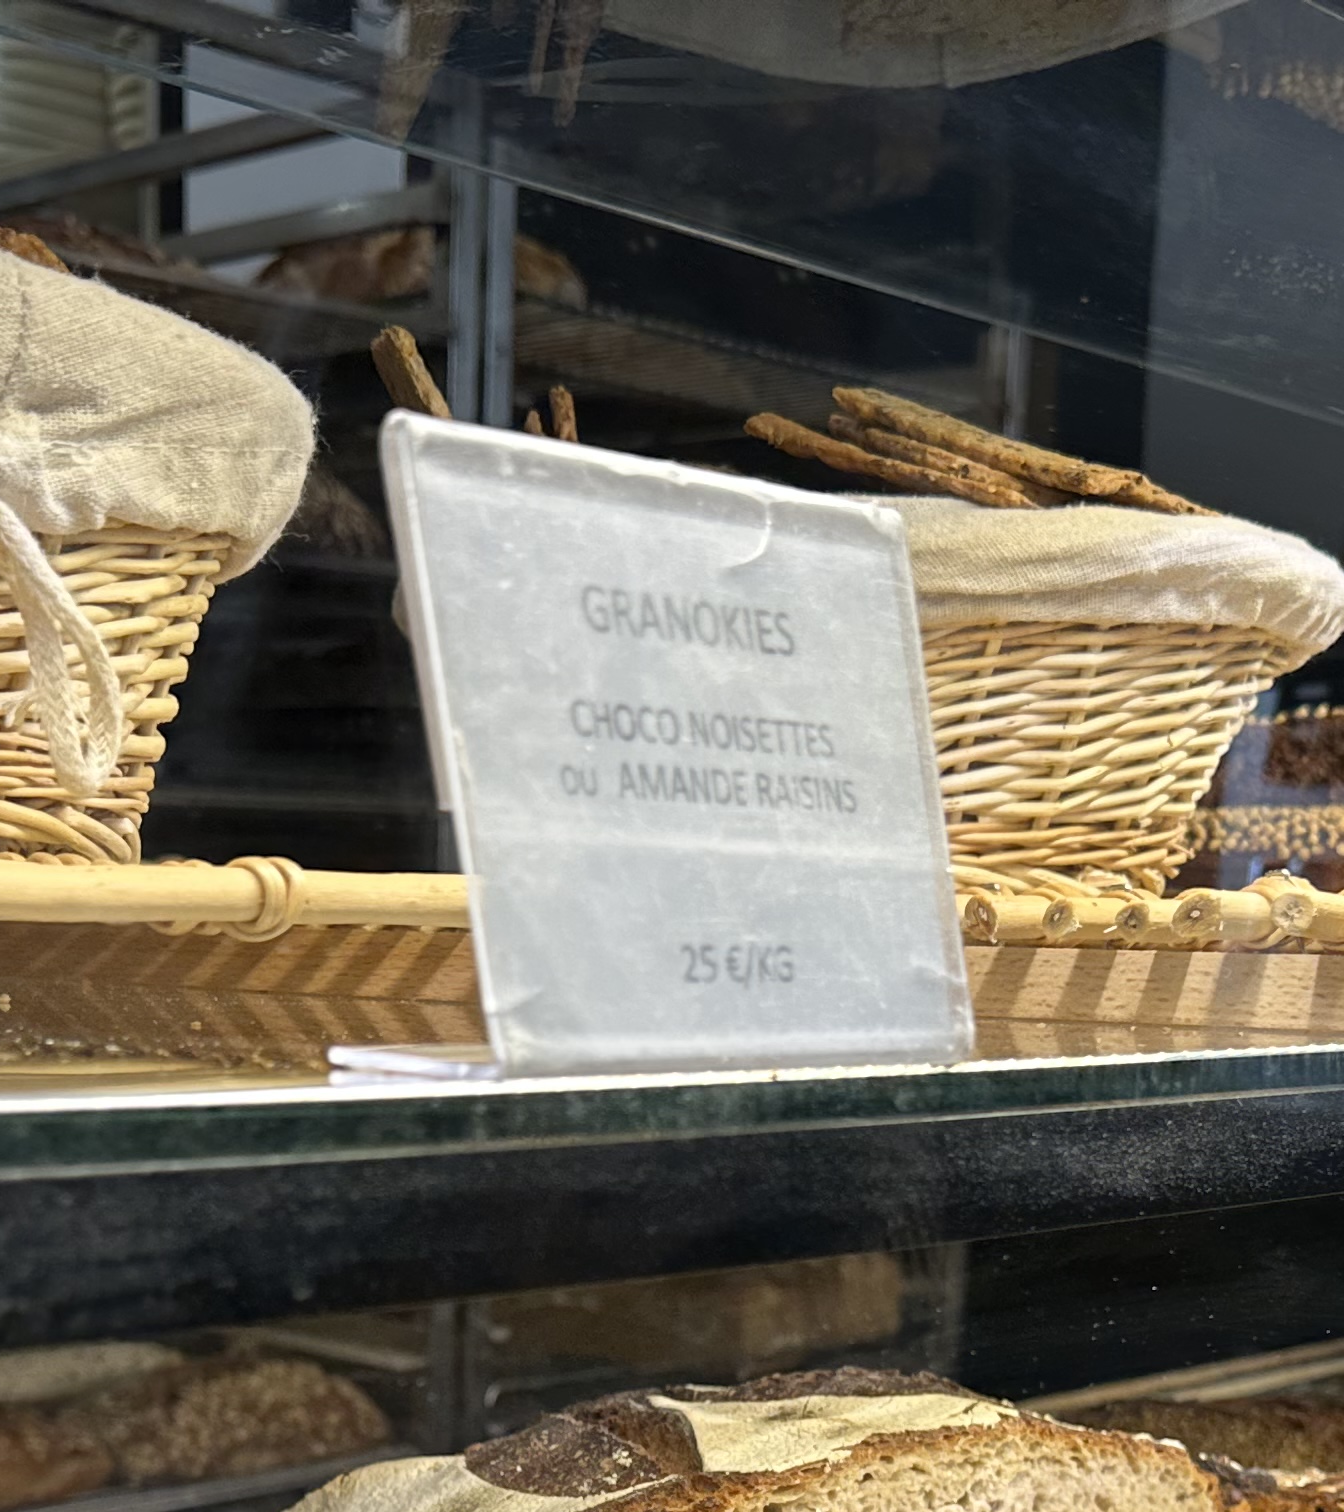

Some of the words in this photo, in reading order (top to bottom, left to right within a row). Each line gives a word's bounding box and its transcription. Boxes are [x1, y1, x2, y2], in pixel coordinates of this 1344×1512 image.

[580, 584, 795, 657] GRANOKIES
[569, 698, 680, 746] CHOCO
[687, 710, 836, 758] NOISETTES
[618, 761, 749, 808] AMANDE
[679, 943, 719, 984] 25
[724, 941, 795, 990] €/KG
